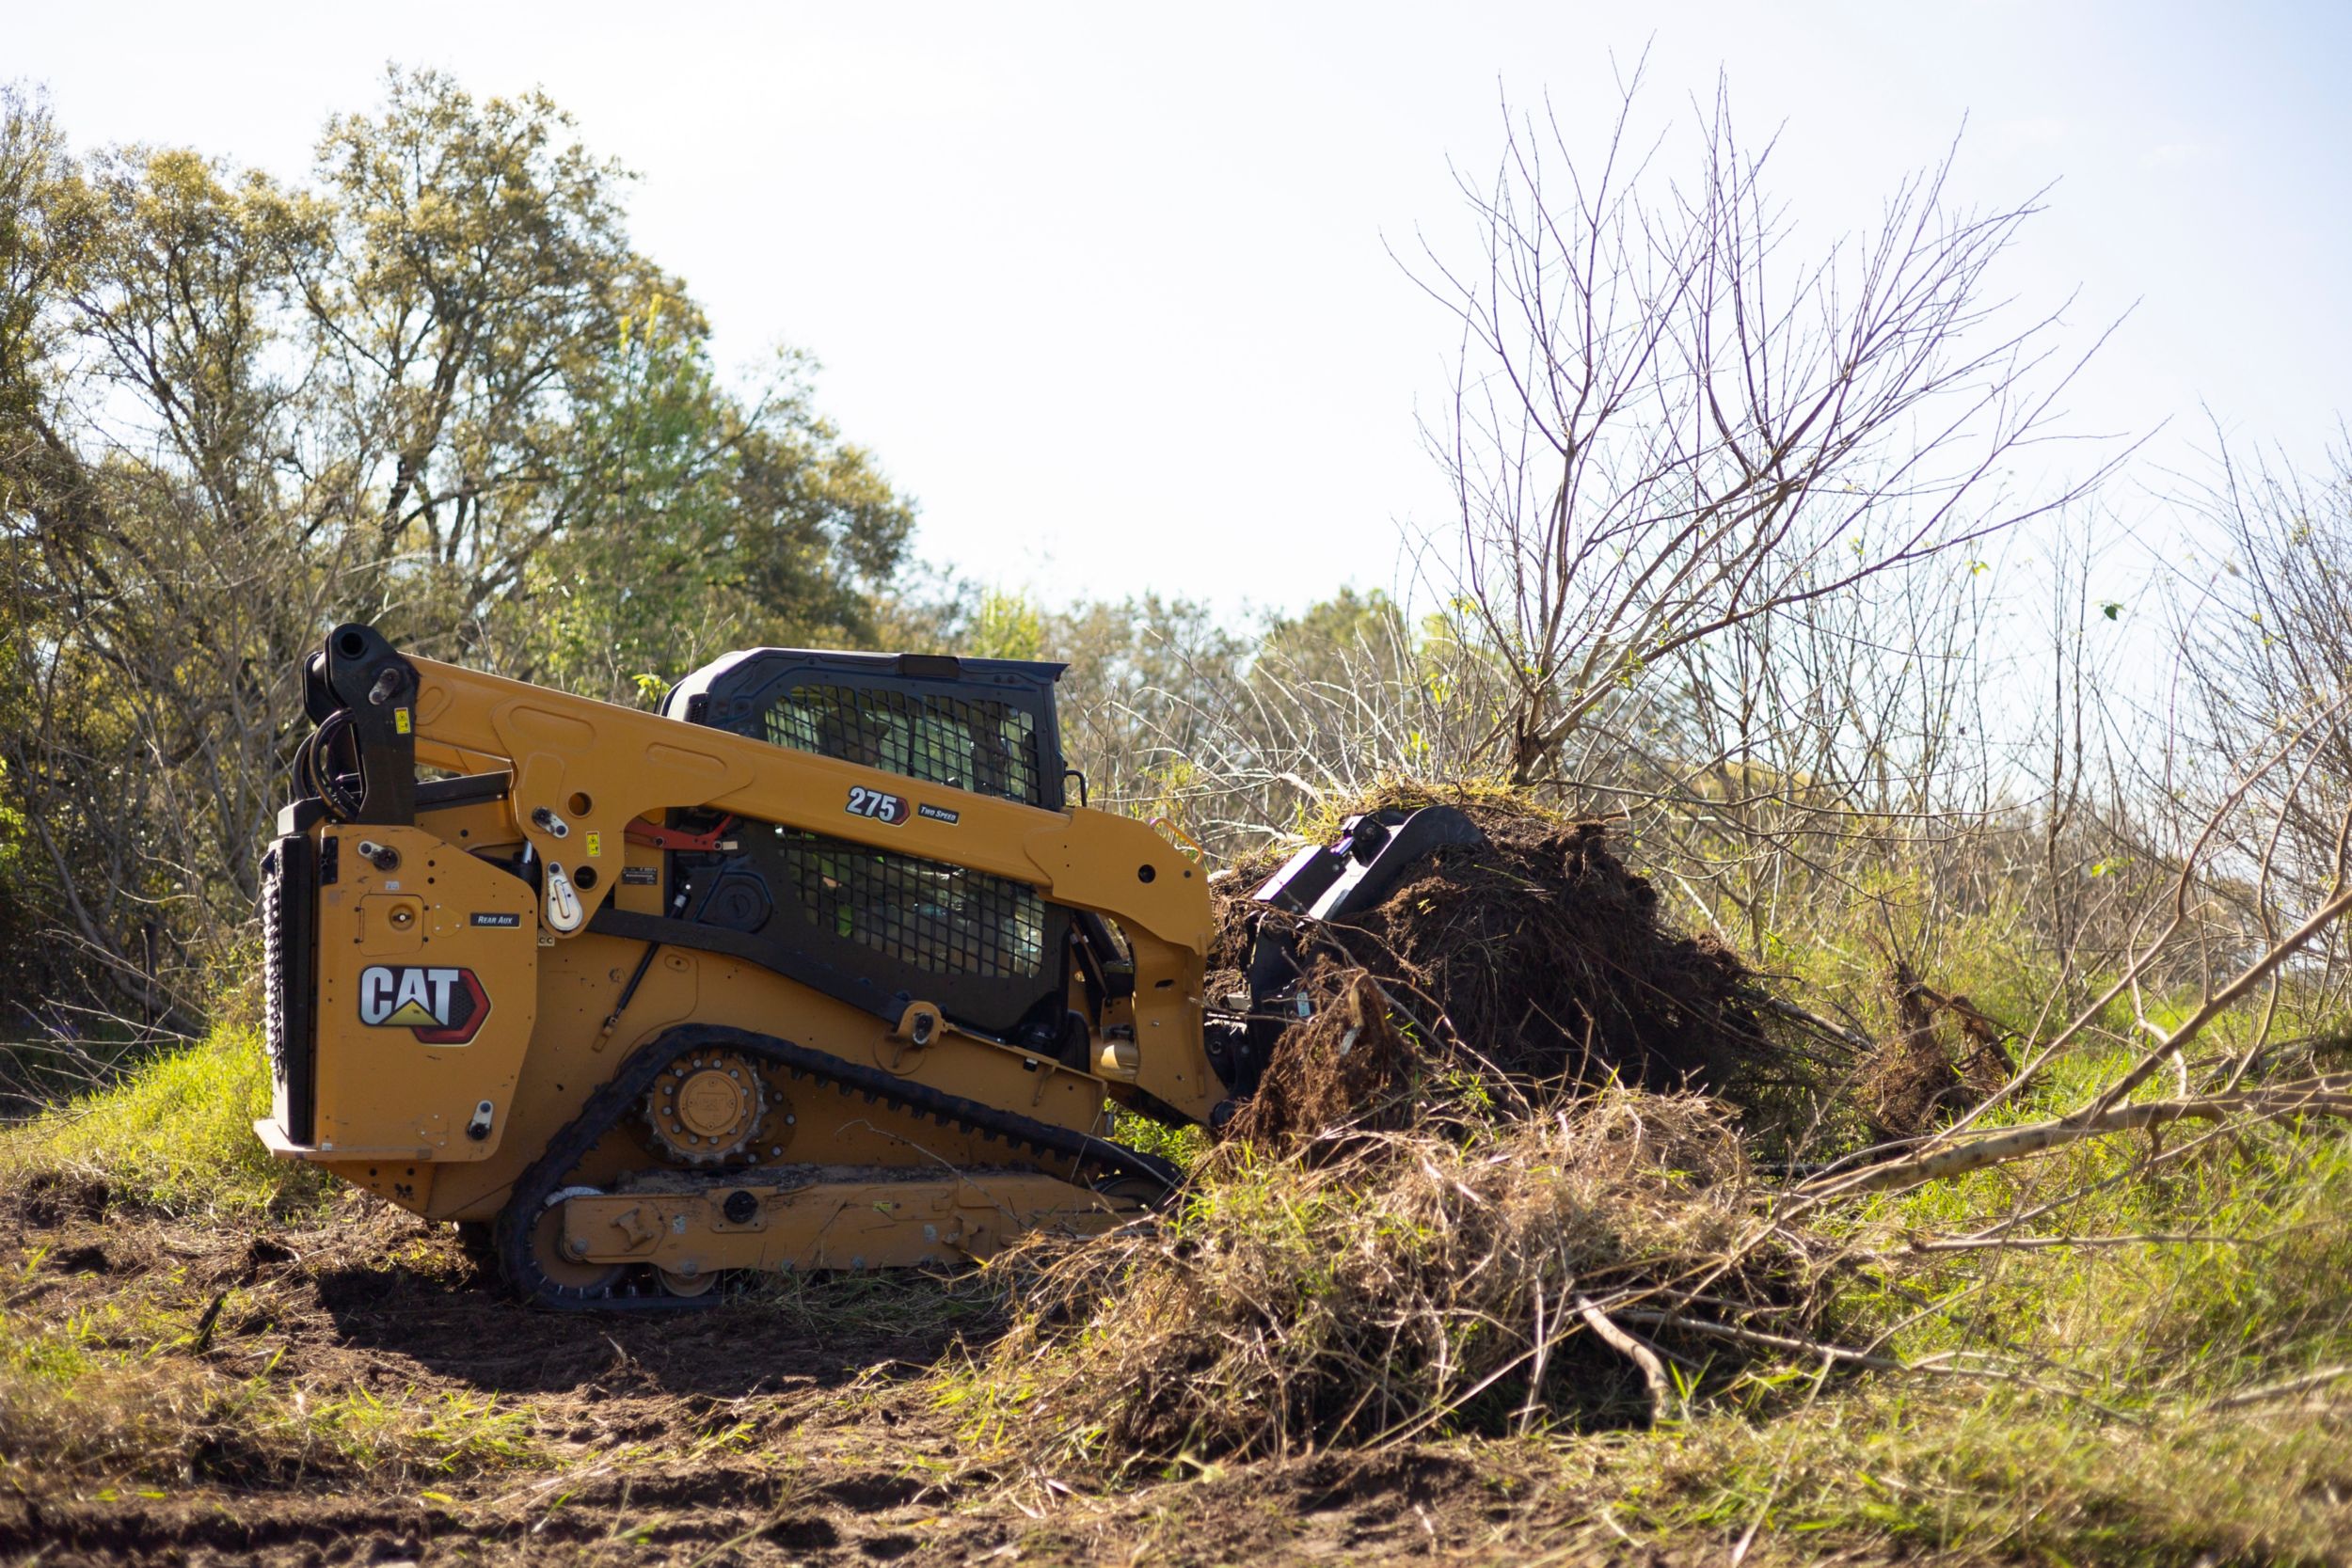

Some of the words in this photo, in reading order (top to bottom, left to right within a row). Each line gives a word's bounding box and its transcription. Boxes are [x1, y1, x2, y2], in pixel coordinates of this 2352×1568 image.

[847, 787, 897, 821] 275
[935, 810, 957, 821] SPEED
[477, 915, 497, 924] REAR
[498, 916, 513, 925] AUX
[361, 967, 458, 1025] CAT
